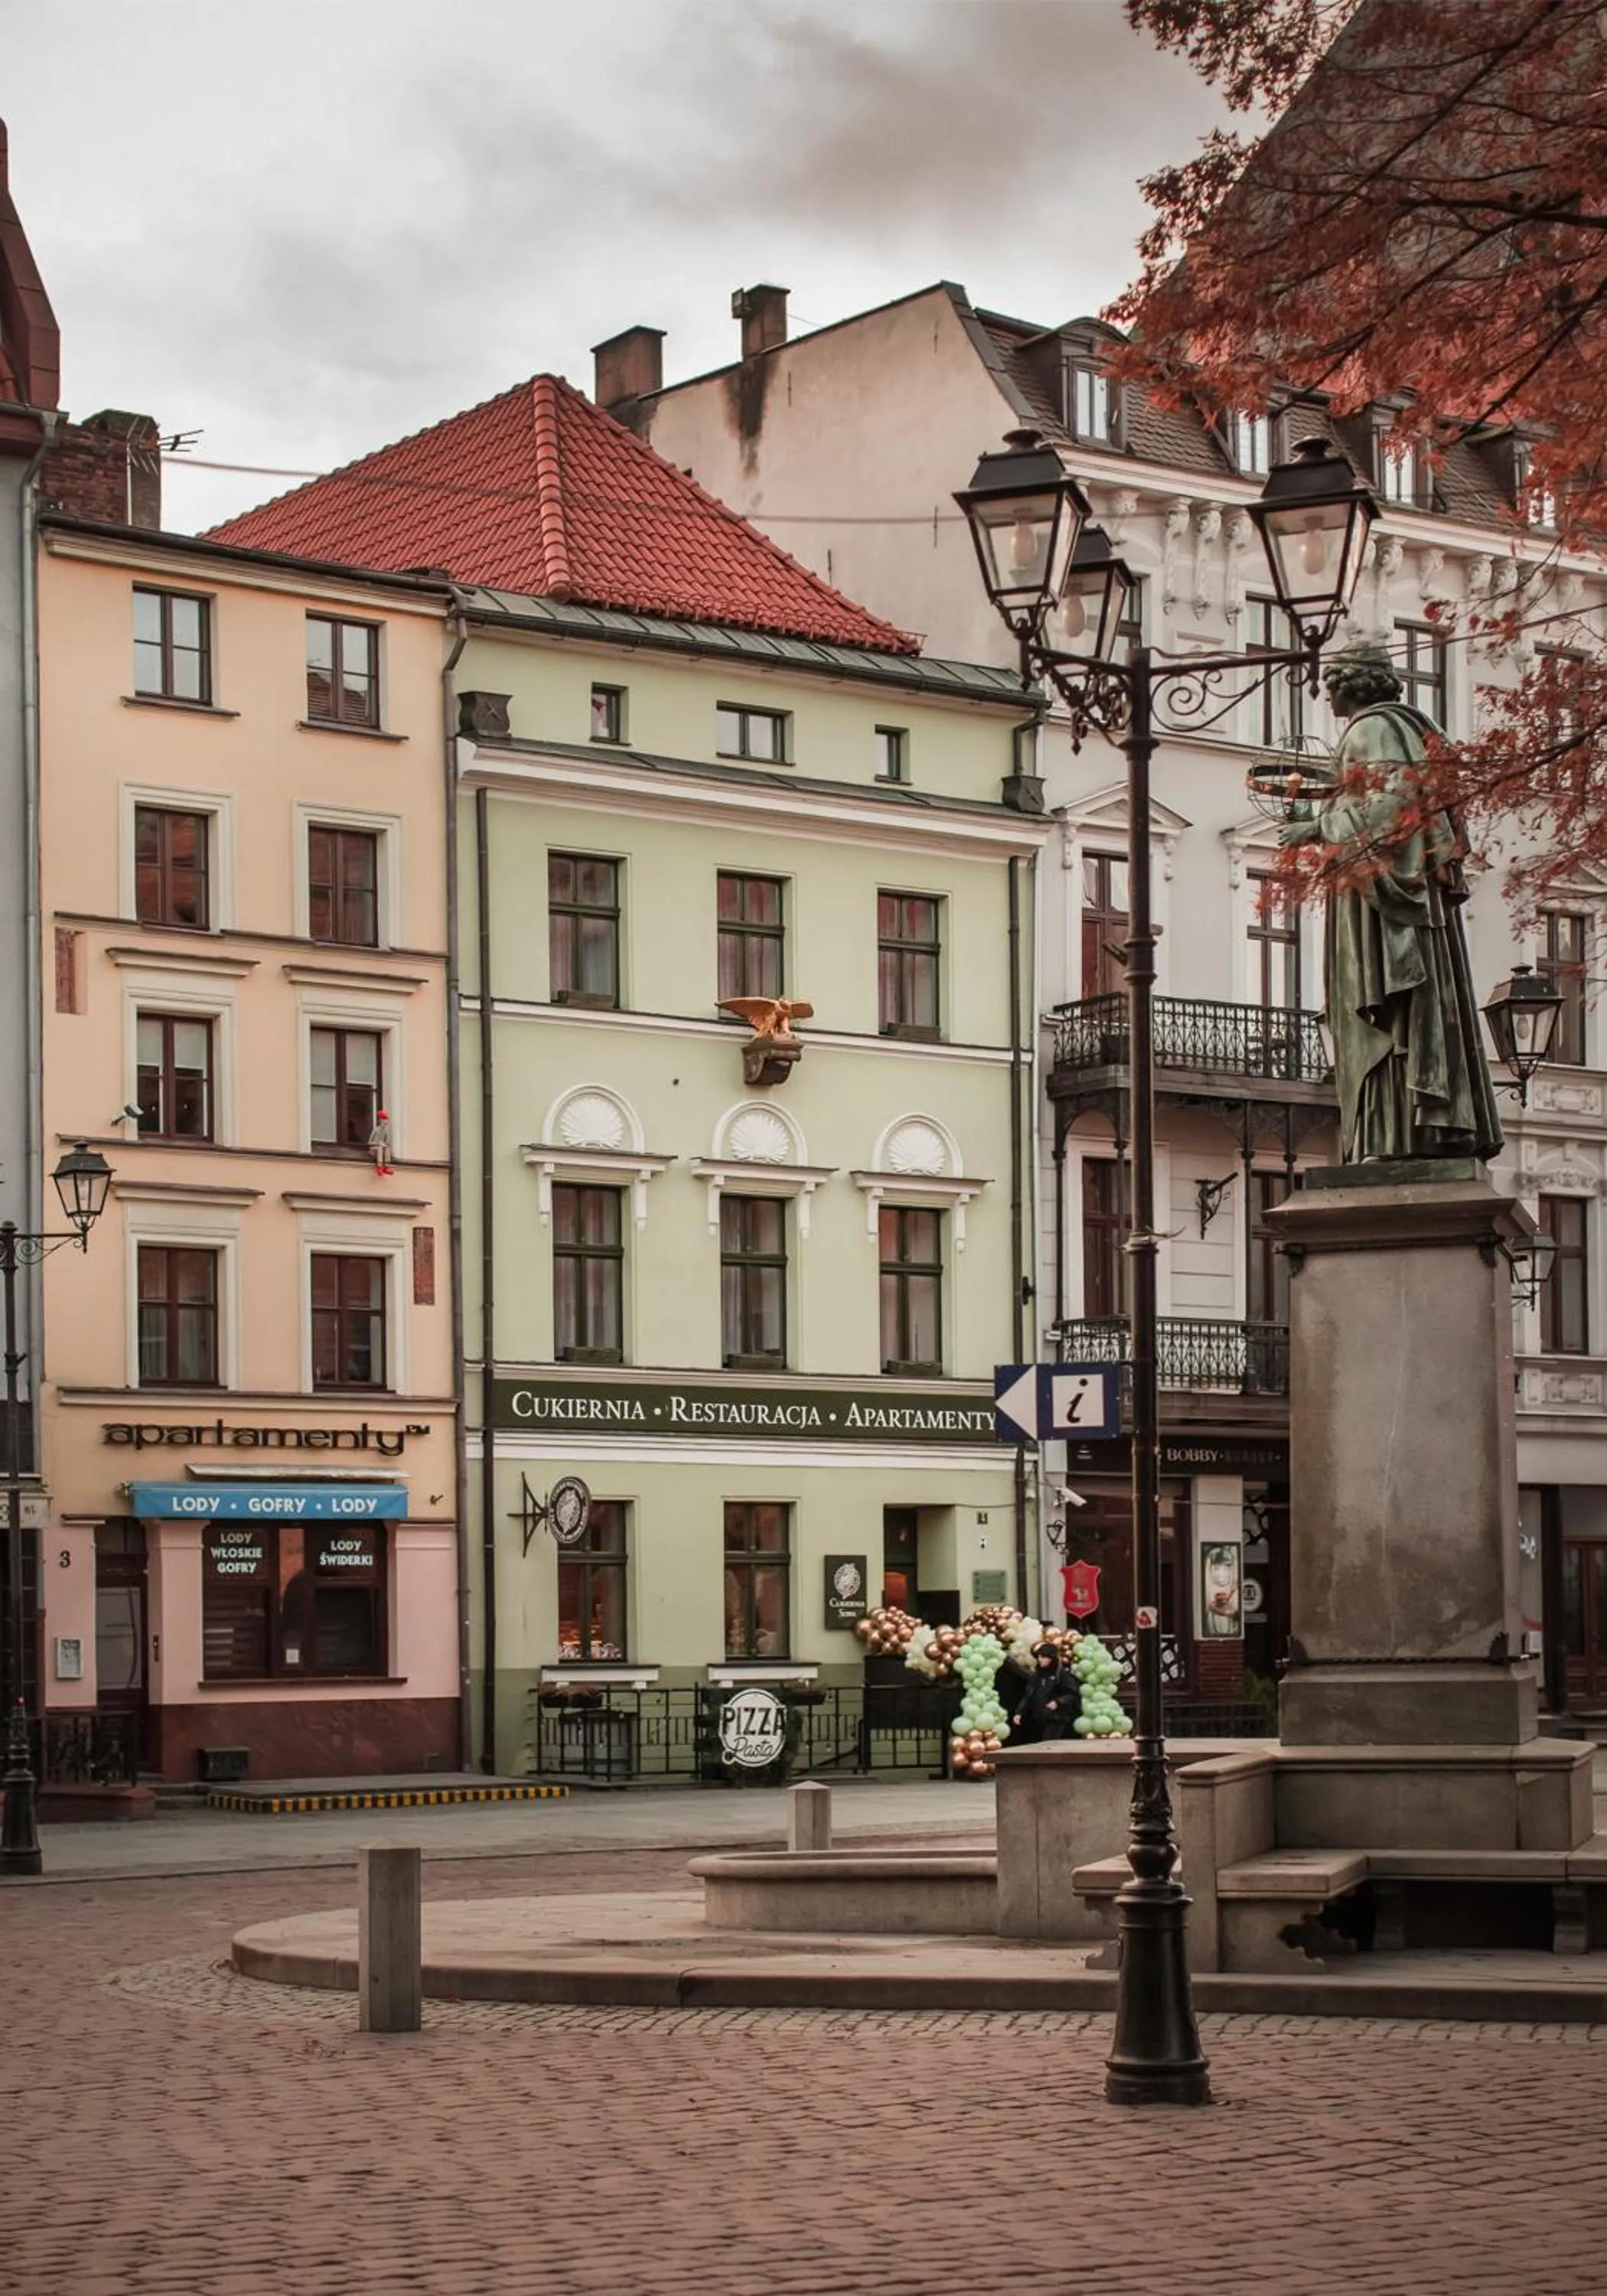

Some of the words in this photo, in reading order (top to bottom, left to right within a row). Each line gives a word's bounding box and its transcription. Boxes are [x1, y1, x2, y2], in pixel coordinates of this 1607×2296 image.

[511, 1391, 646, 1420] CUKIERNIA
[670, 1396, 822, 1430] RESTAURACJA
[844, 1402, 995, 1430] APARTAMENTY
[103, 1418, 406, 1456] apartamenty
[1166, 1448, 1219, 1462] BOBBY
[172, 1496, 221, 1513] LODY
[248, 1497, 307, 1514] GOFRY
[331, 1498, 377, 1515] LODY
[220, 1532, 253, 1544] LODY
[330, 1540, 362, 1552] LODY
[60, 1550, 71, 1568] 3
[217, 1561, 257, 1574] GOFRY
[318, 1552, 373, 1566] ŚWIDERKI
[722, 1707, 785, 1736] PIZZA
[733, 1737, 774, 1758] Pasta
